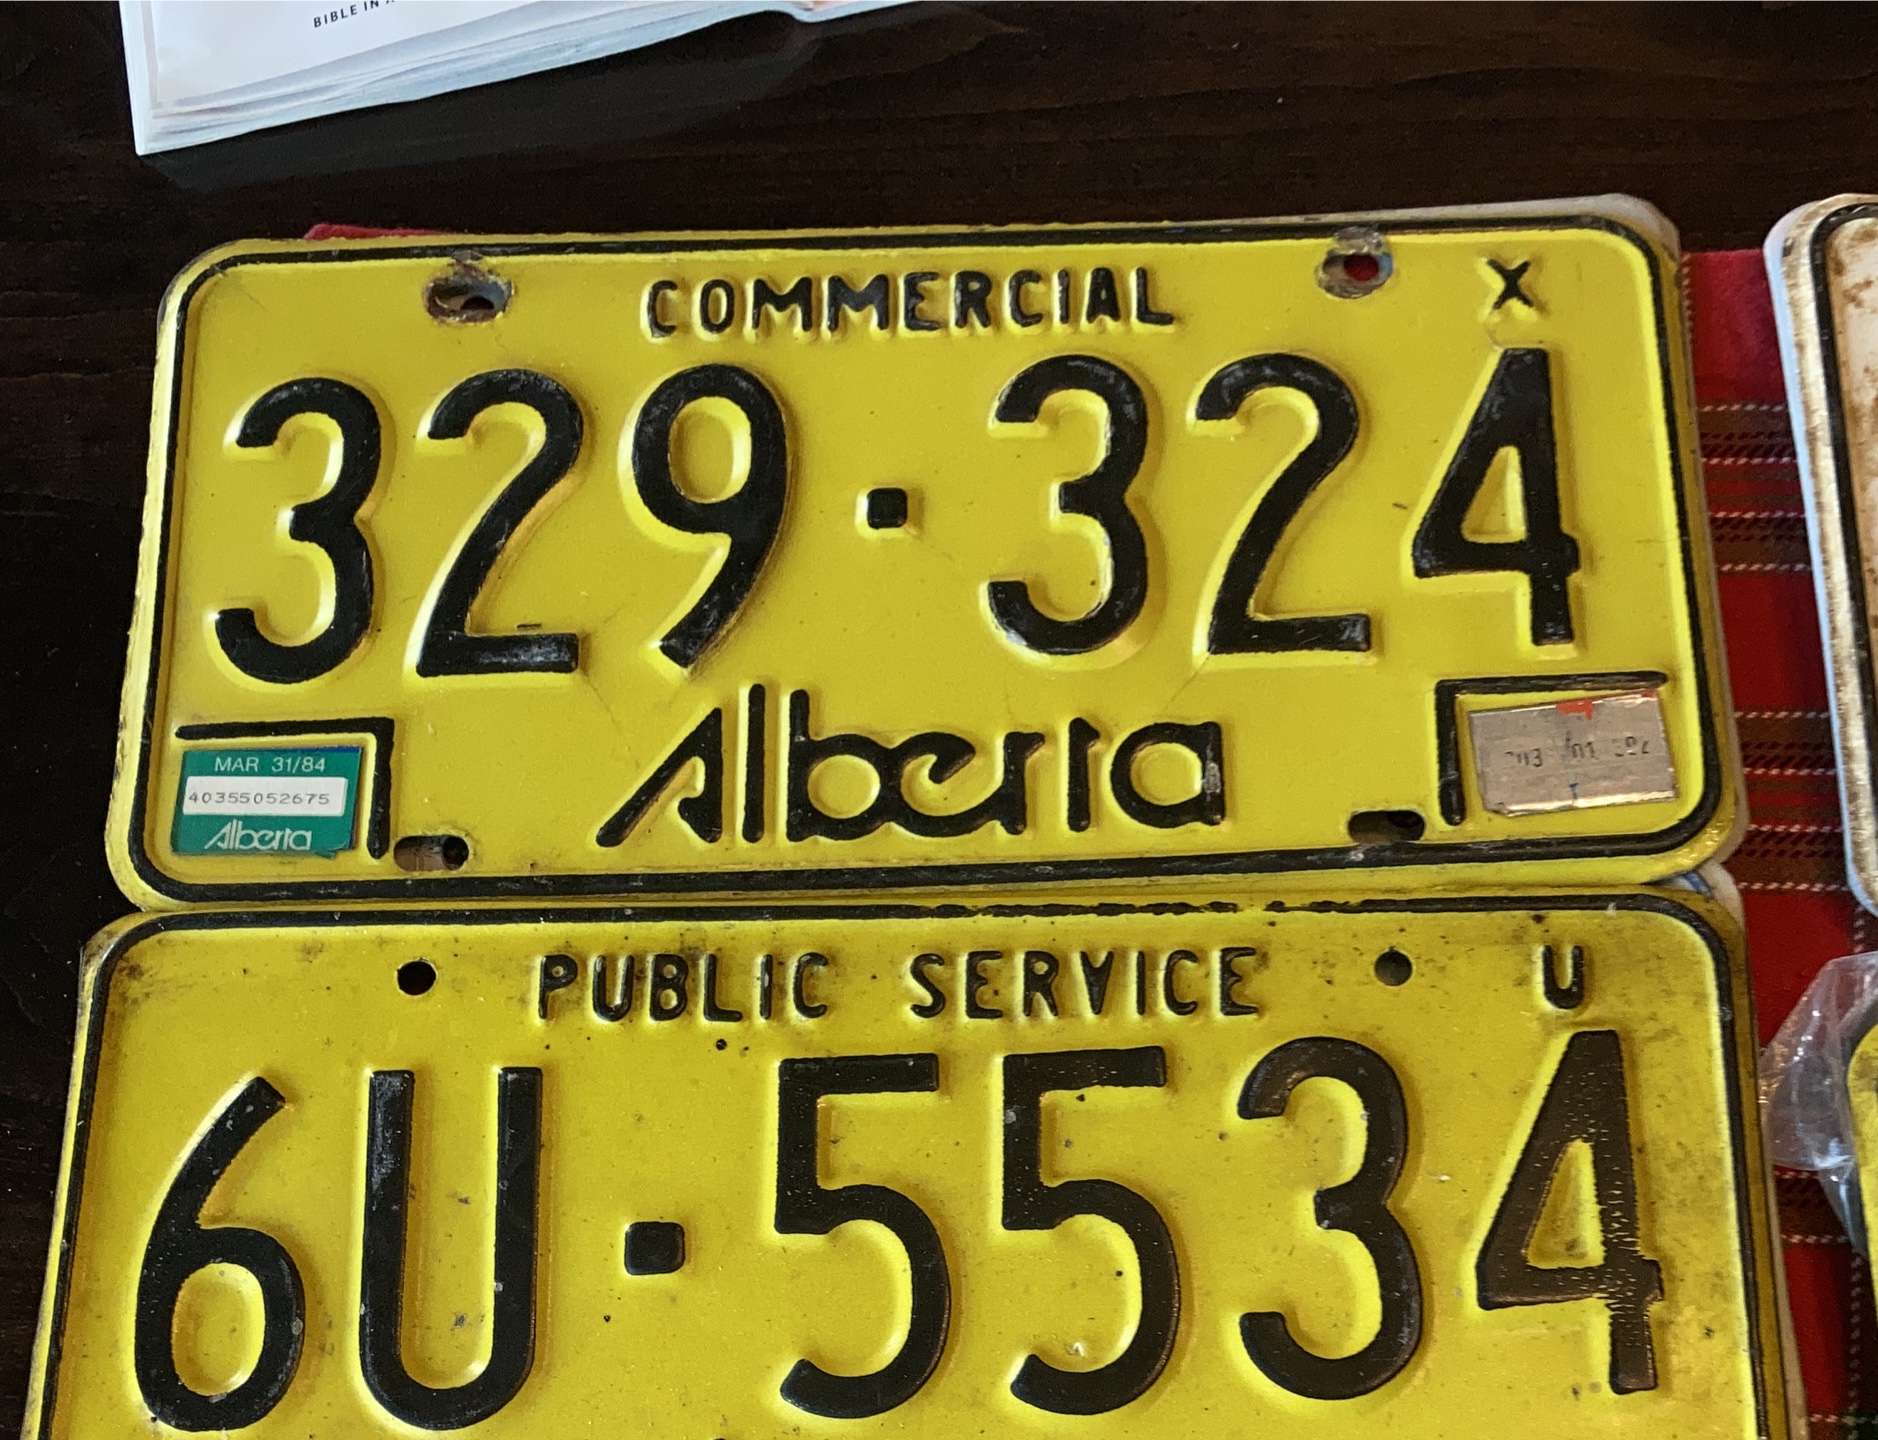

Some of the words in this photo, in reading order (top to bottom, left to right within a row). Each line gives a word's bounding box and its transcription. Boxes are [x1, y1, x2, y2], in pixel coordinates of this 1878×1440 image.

[313, 4, 357, 28] BIBLE
[648, 267, 1176, 336] COMMERCIAL
[1488, 259, 1530, 309] X
[215, 757, 259, 772] MAR
[271, 756, 326, 773] 31/84
[597, 684, 1226, 848] Alberta
[188, 791, 330, 805] 40355052675
[204, 819, 312, 850] Alberta
[538, 953, 829, 1022] PUBLIC
[908, 947, 1259, 1020] SERVICE
[1541, 944, 1584, 1009] U
